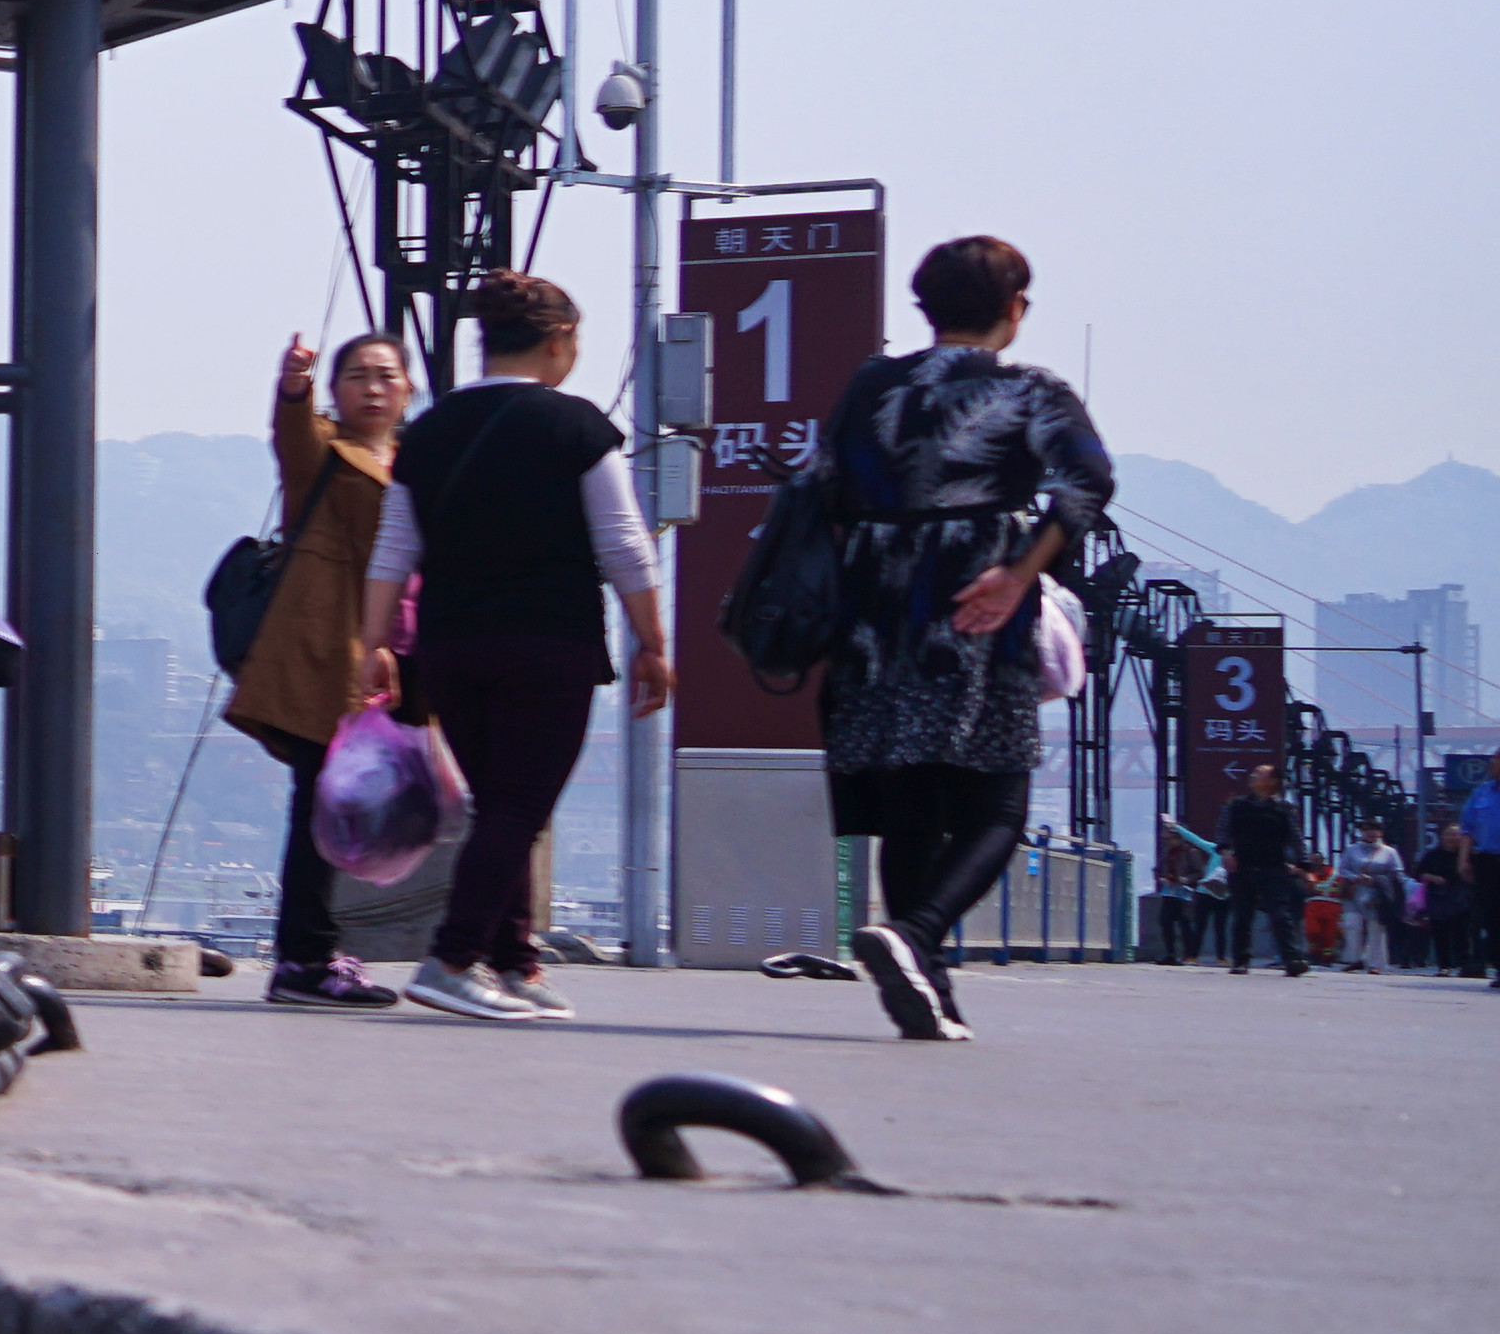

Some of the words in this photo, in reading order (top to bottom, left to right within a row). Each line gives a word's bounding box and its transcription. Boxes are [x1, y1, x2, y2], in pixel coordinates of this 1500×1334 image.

[714, 223, 840, 254] 朝天门
[737, 279, 792, 402] 1
[712, 418, 821, 470] 码头
[1214, 656, 1257, 712] 3
[1204, 719, 1268, 742] 码头
